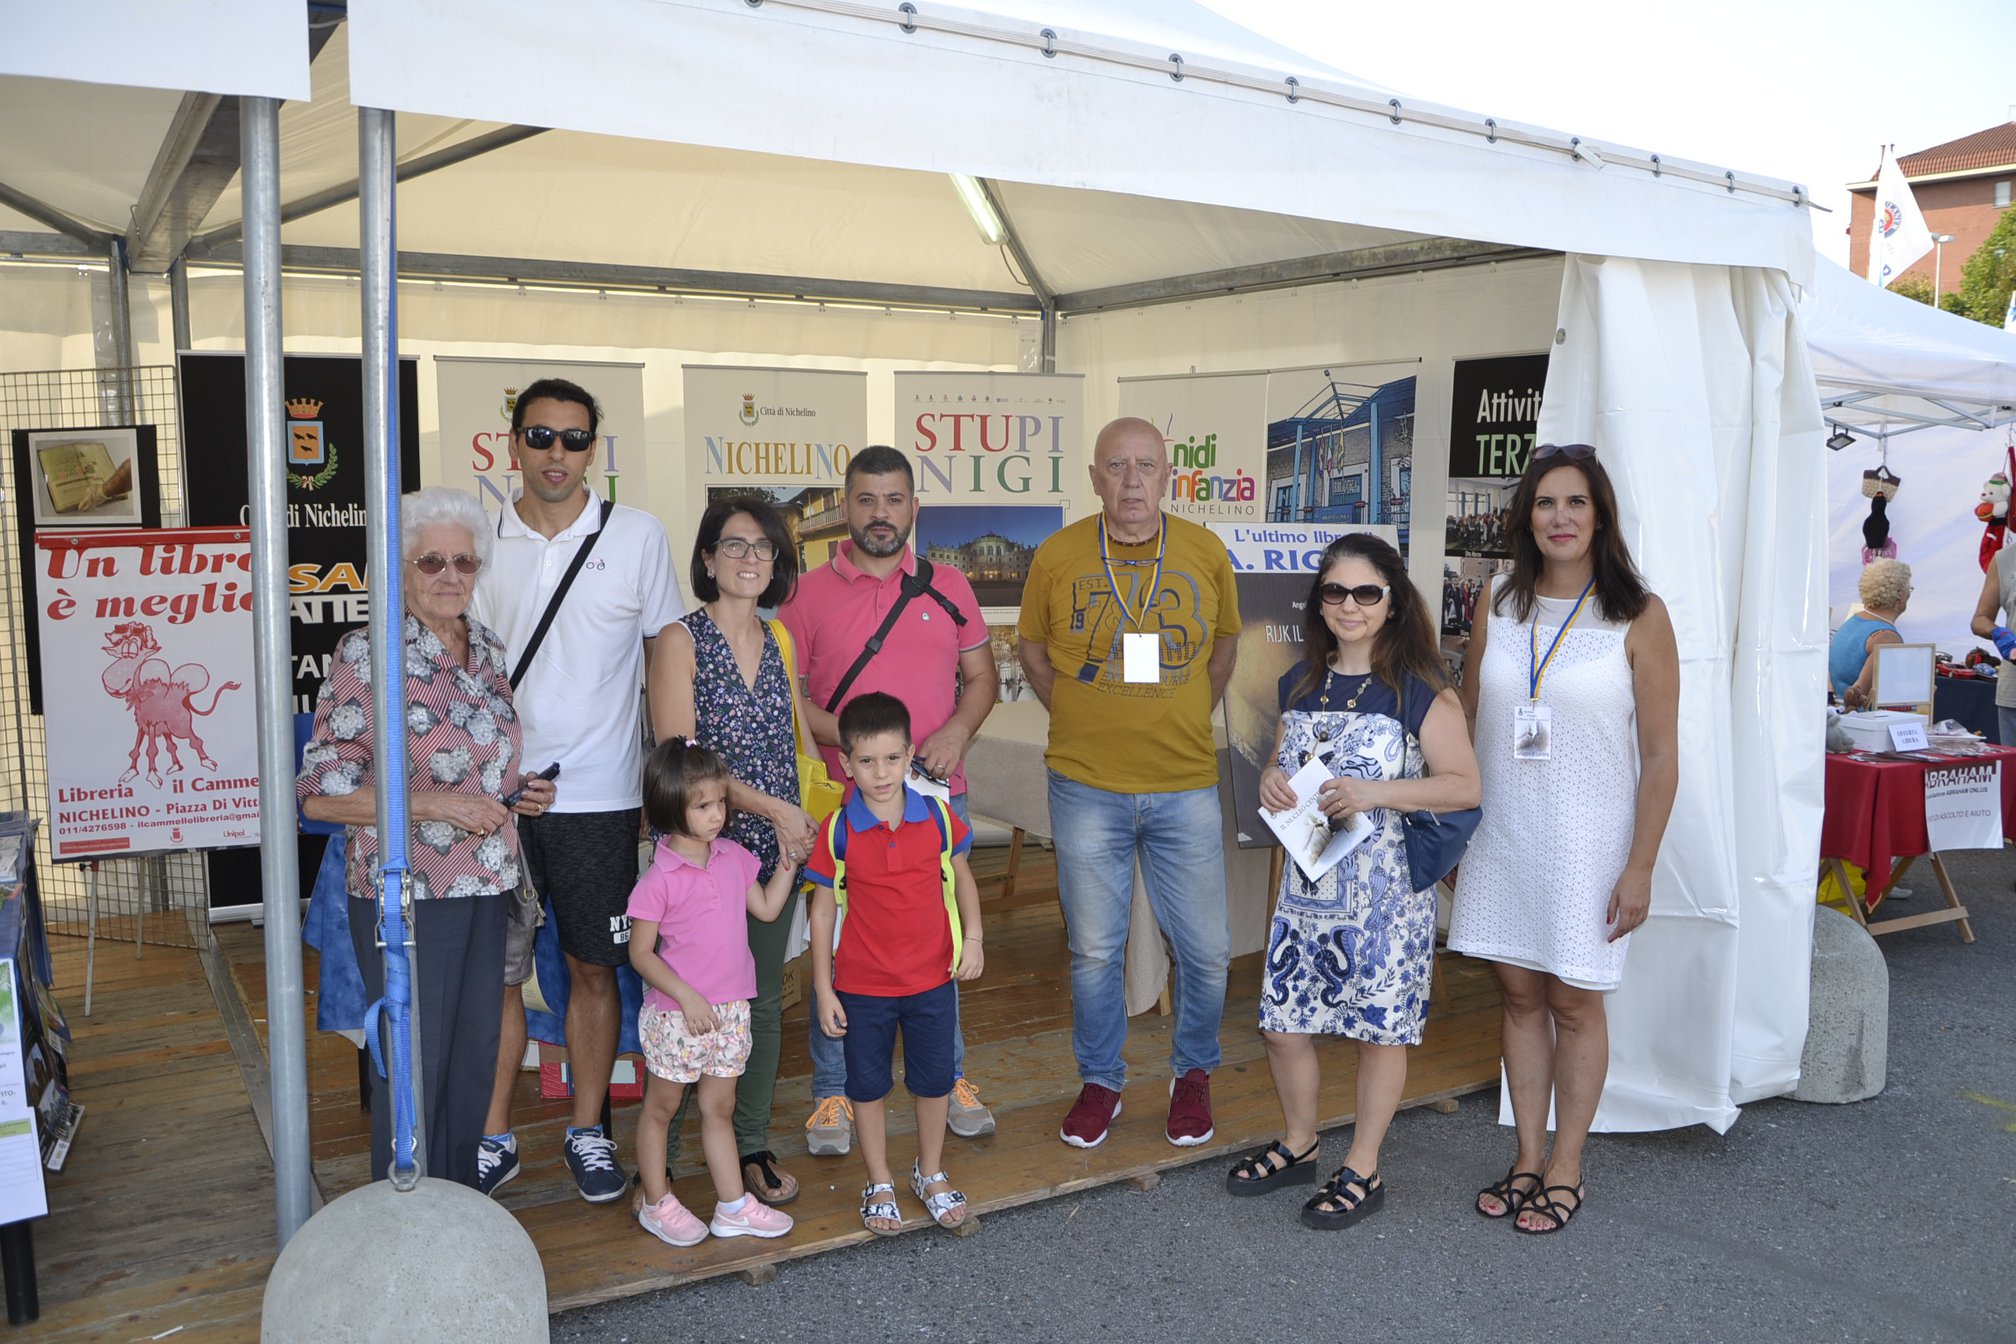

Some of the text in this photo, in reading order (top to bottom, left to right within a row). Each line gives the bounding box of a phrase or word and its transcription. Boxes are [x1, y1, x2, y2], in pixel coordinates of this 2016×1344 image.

[760, 406, 817, 417] Città di Nichelino
[1476, 388, 1542, 423] Attivit
[915, 413, 1064, 452] STUPI
[704, 436, 851, 480] NICHELINO
[1173, 433, 1217, 469] nidi
[1475, 433, 1537, 475] TERZ
[916, 455, 1064, 493] NIGI
[1171, 468, 1255, 503] infanzia
[304, 502, 367, 528] Nichelin
[1170, 504, 1255, 516] NICHELINO
[1234, 529, 1342, 543] L'ultimo libr
[47, 548, 120, 579] Un
[47, 588, 77, 620] è
[1098, 682, 1176, 699] EXCELLENCE
[58, 777, 260, 803] Libreria il Camme
[59, 805, 150, 824] NICHELINO
[166, 802, 207, 815] Piazza
[212, 798, 227, 811] Di
[231, 796, 260, 809] Vitt
[59, 822, 127, 835] 011/4276598
[137, 811, 260, 828] ilcammellolibreria@gmai
[1970, 809, 1992, 817] AIUTO
[223, 829, 246, 839] Unipol
